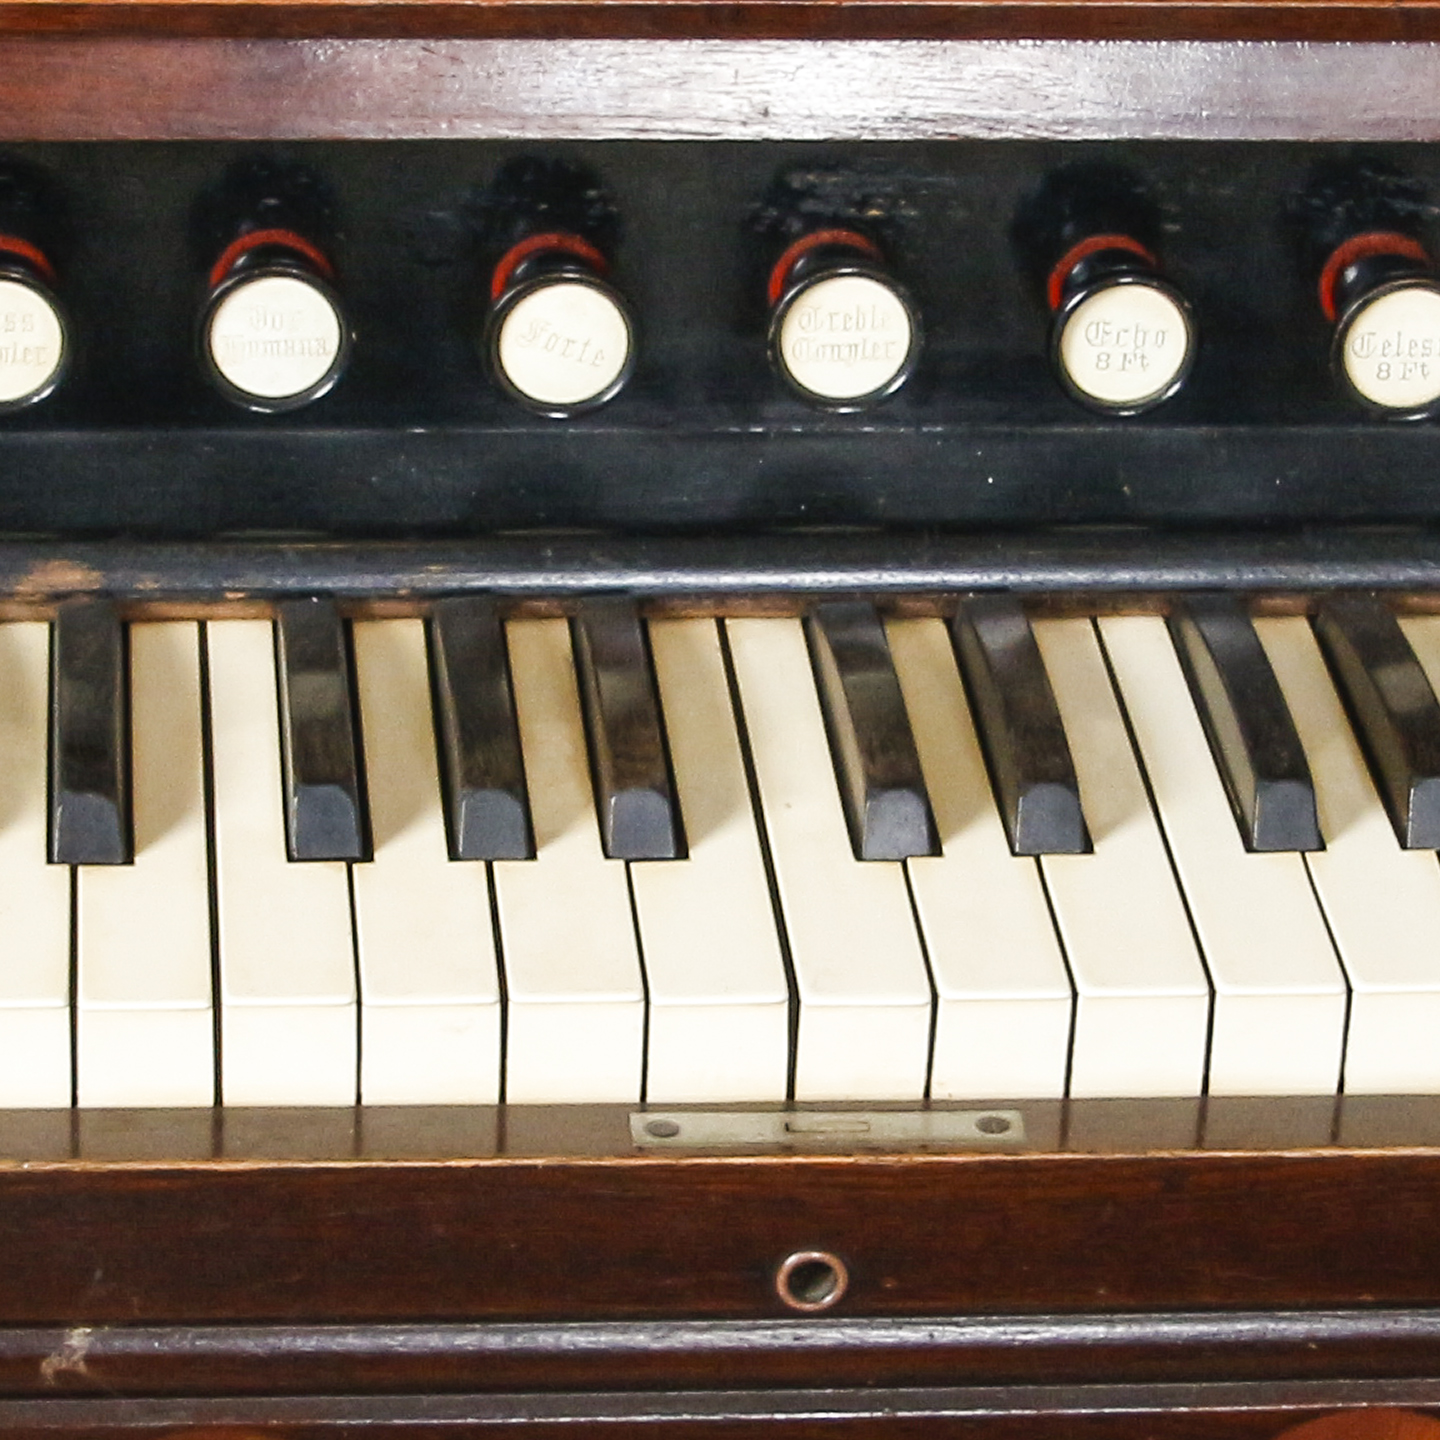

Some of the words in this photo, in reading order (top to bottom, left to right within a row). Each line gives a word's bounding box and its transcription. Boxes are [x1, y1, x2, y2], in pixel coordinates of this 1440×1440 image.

[516, 317, 606, 369] Forte
[1085, 320, 1170, 349] Echo
[1095, 352, 1110, 371] 8
[1117, 352, 1150, 371] Ft
[1376, 361, 1392, 381] 8
[1399, 361, 1431, 381] Ft
